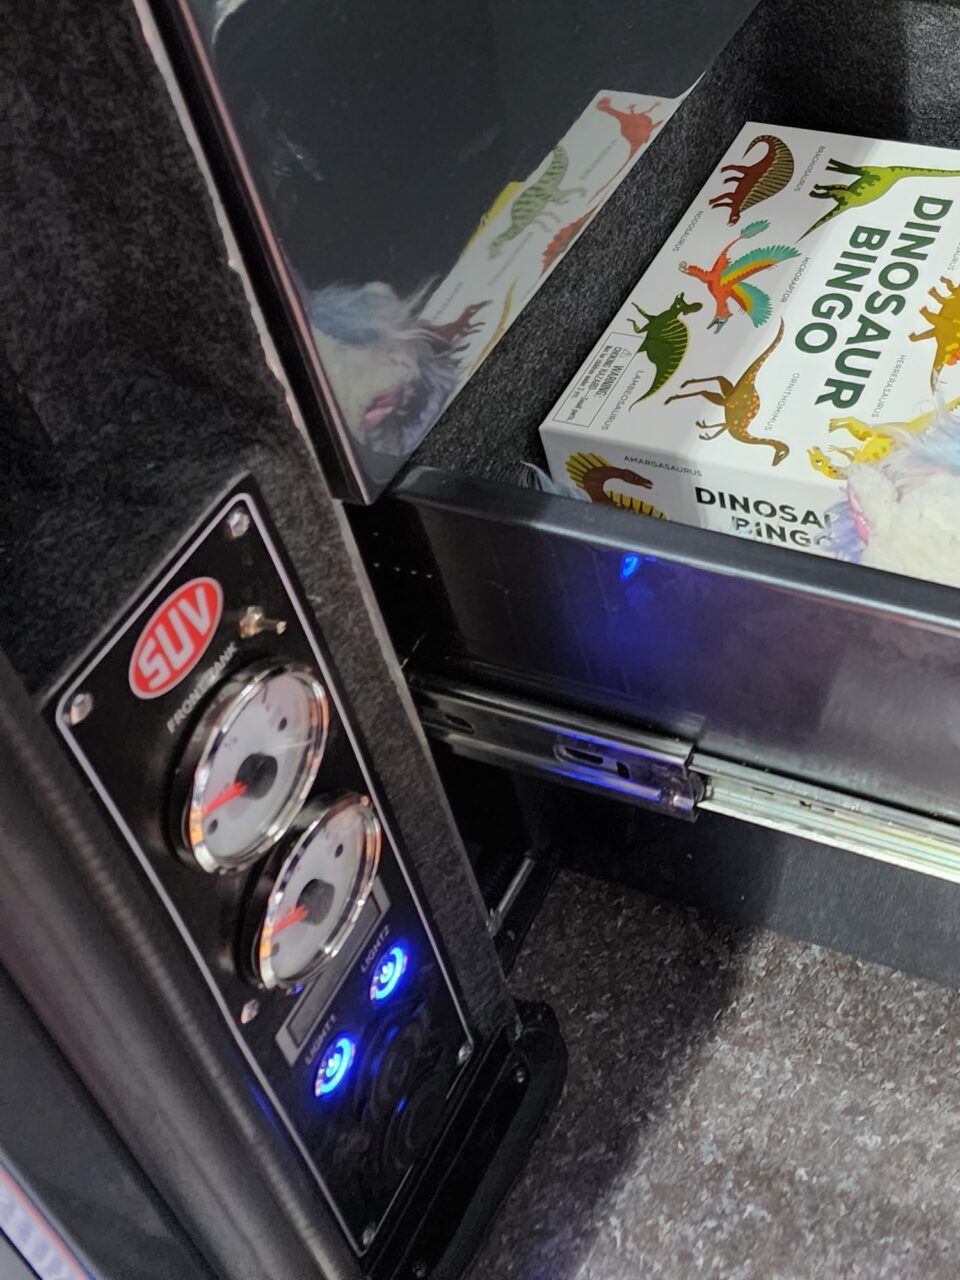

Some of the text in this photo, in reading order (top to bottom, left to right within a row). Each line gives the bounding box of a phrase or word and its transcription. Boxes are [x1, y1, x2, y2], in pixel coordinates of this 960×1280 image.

[672, 210, 704, 252] NODOSAURUS
[781, 257, 810, 303] MICRORAPTOR
[795, 225, 891, 354] BINGO
[815, 195, 953, 409] DINOSAUR
[601, 346, 622, 368] CHOKING
[871, 354, 907, 418] HERRERASAURUS
[601, 370, 644, 431] LAMBEOSAURUS
[764, 373, 800, 431] ORNITHOMIMUS
[623, 455, 702, 478] AMARGASAURUS
[694, 486, 832, 530] DINOSA
[138, 585, 211, 690] SUV
